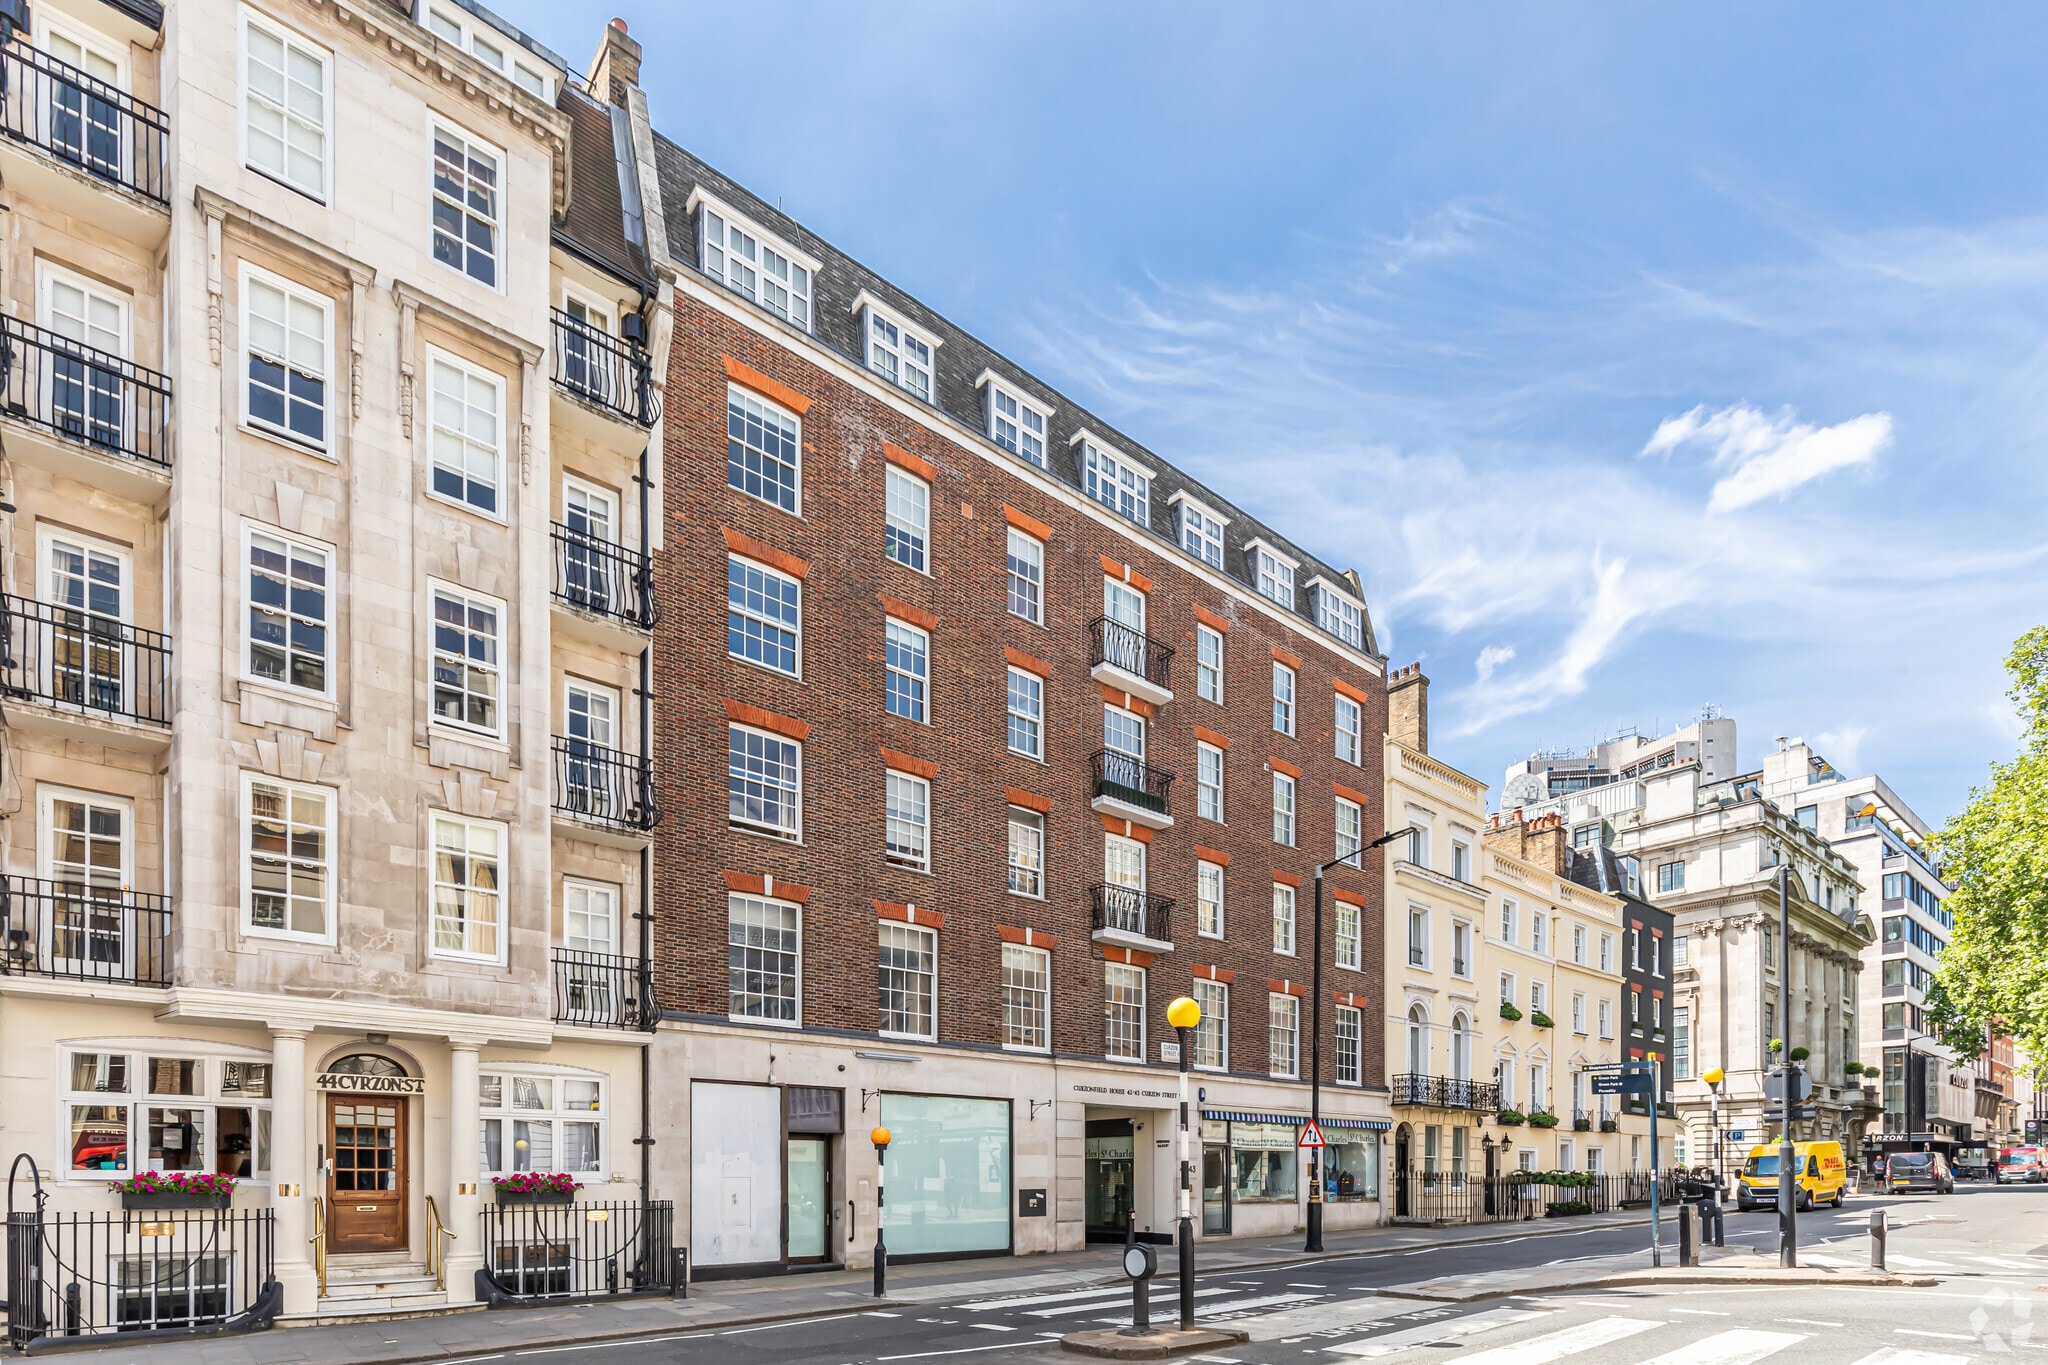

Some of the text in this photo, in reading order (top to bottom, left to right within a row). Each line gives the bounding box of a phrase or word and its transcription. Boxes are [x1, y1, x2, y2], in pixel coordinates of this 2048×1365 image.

[1073, 1085, 1107, 1094] CURZONFIELD
[1141, 1090, 1161, 1098] CURZON
[1327, 1134, 1347, 1144] Charles
[1356, 1133, 1375, 1143] Charles
[1862, 1134, 1904, 1142] CRZON
[1822, 1157, 1842, 1169] DHL
[1310, 1320, 1396, 1338] RIGHT
